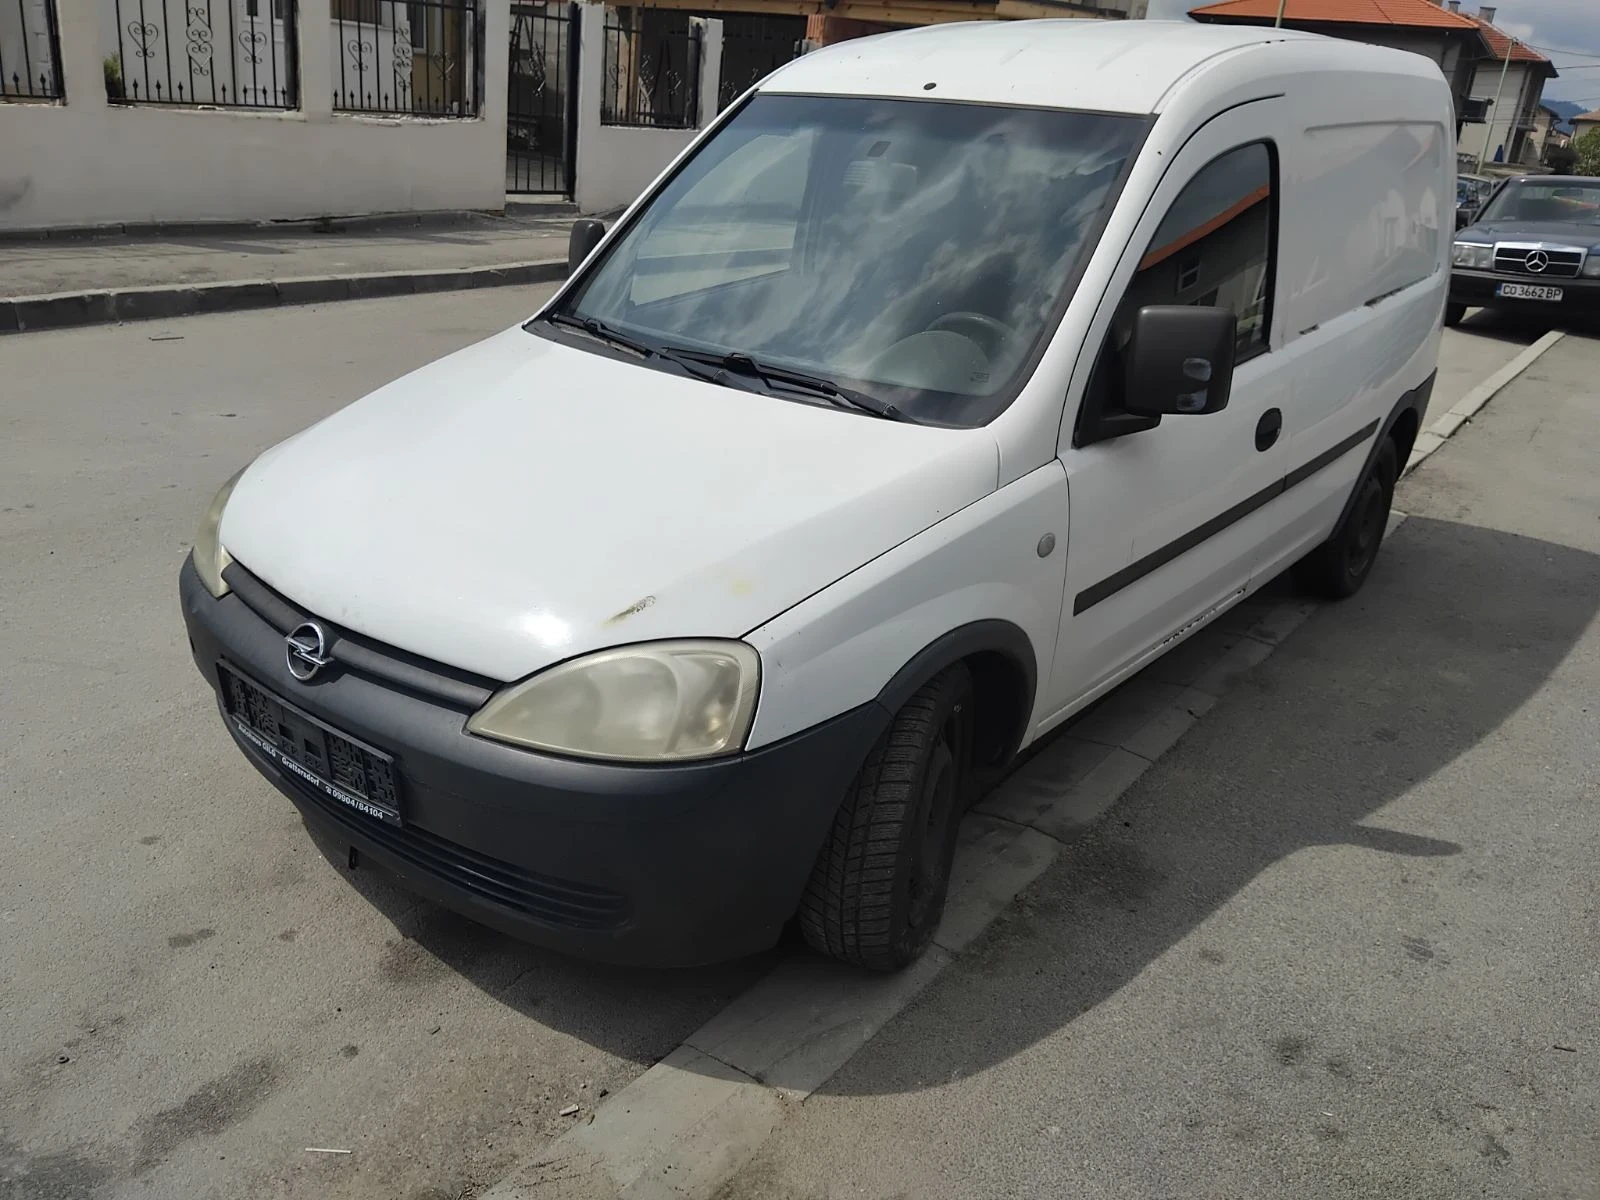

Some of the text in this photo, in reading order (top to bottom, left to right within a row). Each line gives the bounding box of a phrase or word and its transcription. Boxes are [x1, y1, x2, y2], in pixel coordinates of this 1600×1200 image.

[1503, 285, 1561, 299] CO 3662 BP
[281, 756, 320, 787] Grattersdorf
[332, 789, 384, 820] 09904/84104
